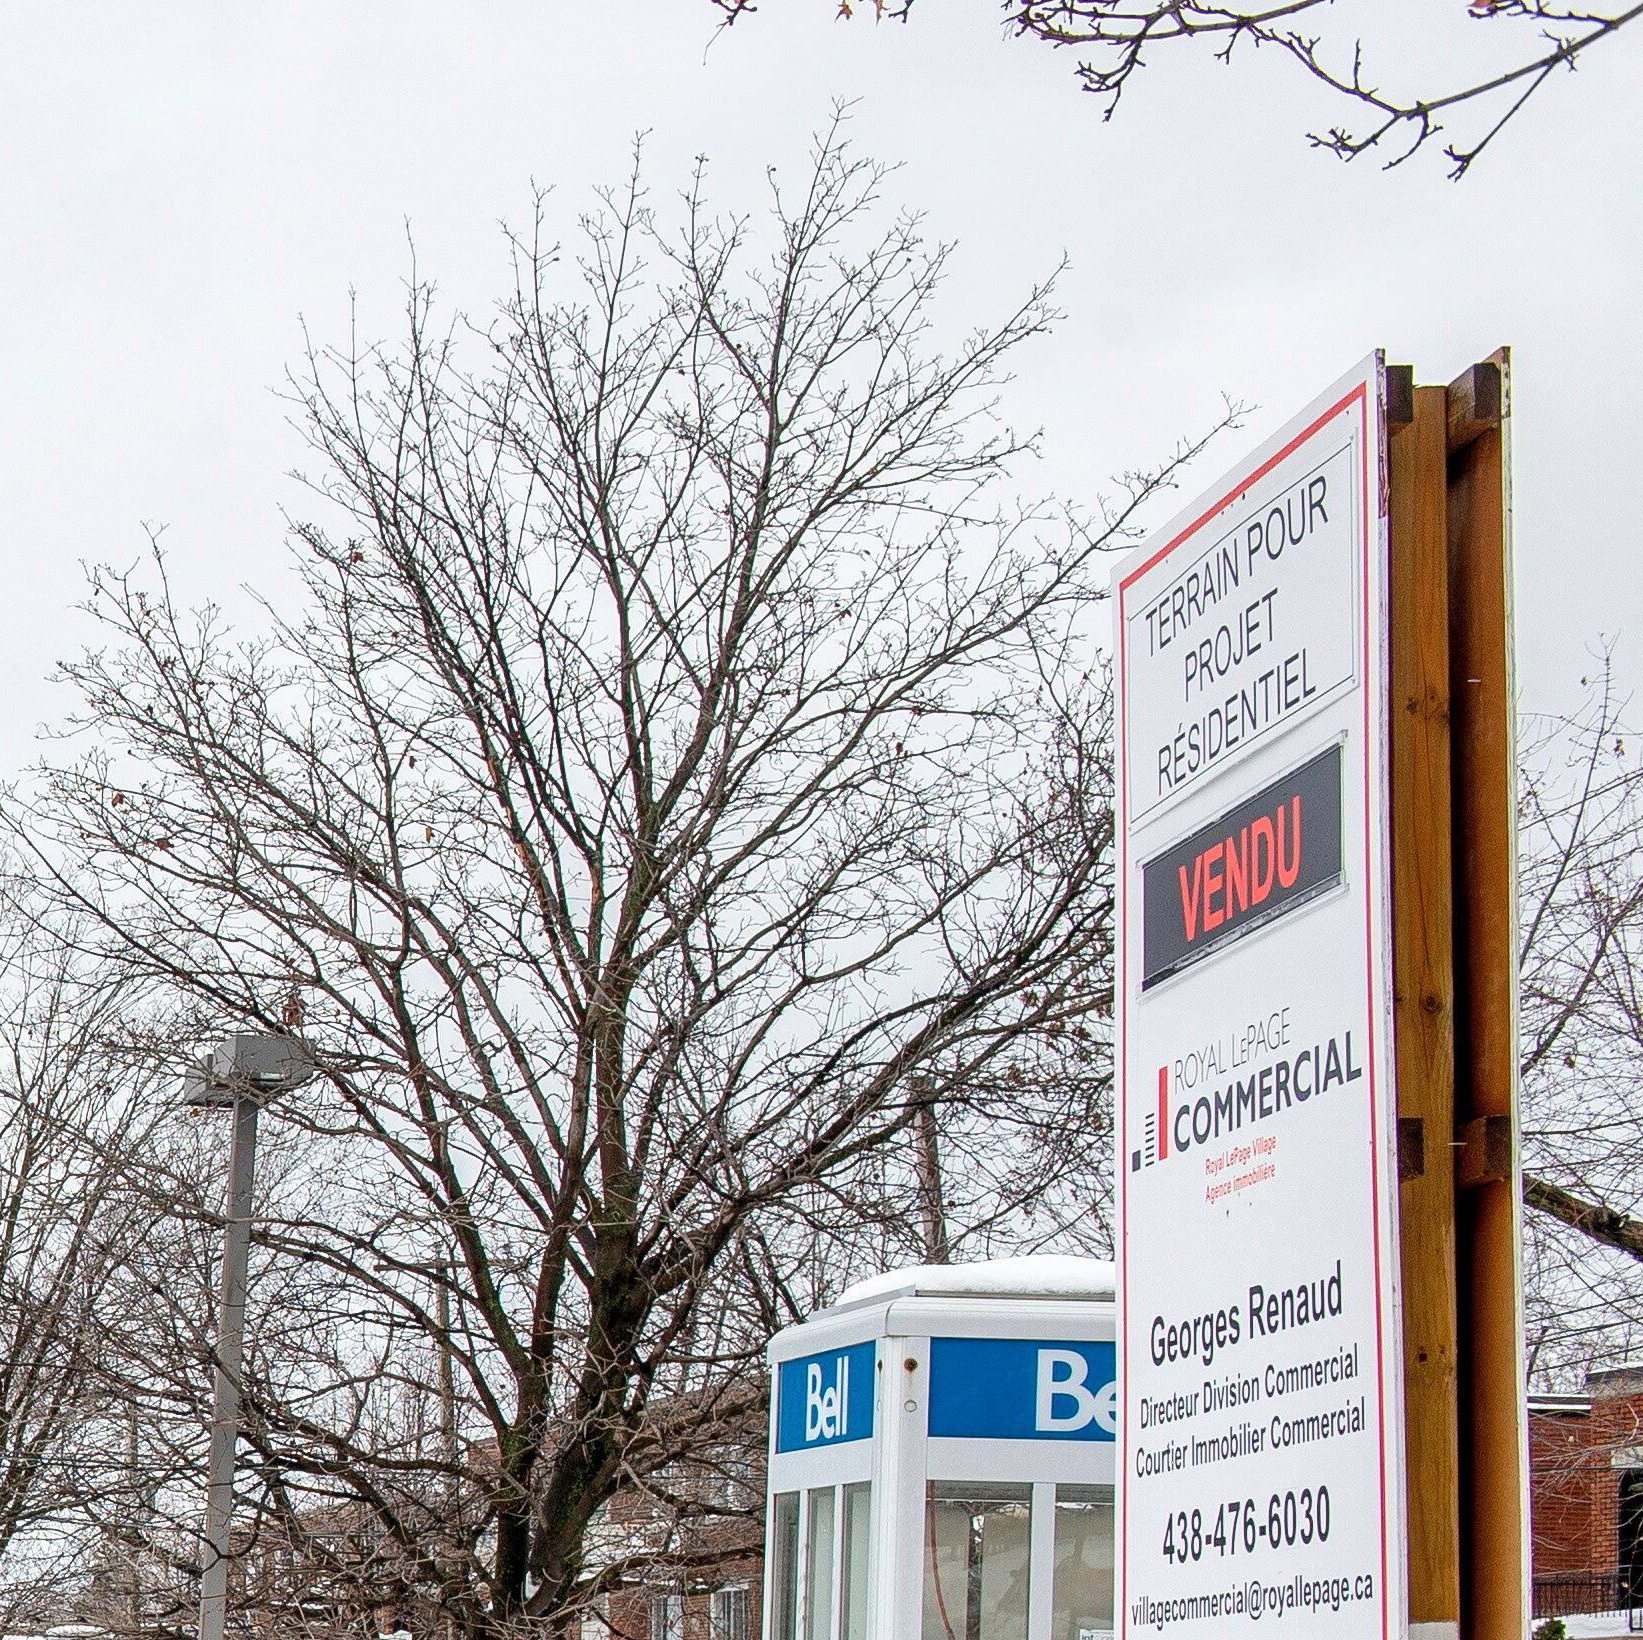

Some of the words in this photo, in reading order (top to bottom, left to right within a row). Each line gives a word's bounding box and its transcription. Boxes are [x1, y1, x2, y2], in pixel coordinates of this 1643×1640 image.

[1145, 538, 1239, 658] TERRAIN
[1247, 475, 1328, 577] POUR
[1185, 587, 1278, 703] PROJET
[1158, 648, 1316, 797] RÉSIDENTIEL
[1178, 794, 1302, 942] VENDU
[1174, 1039, 1227, 1094] ROYAL
[1174, 1030, 1362, 1152] COMMERCIAL
[1205, 1151, 1225, 1177] Royal
[1252, 1135, 1277, 1156] Village
[1205, 1182, 1233, 1204] Agence
[1151, 1305, 1240, 1366] Georges
[1249, 1259, 1343, 1339] Renaud
[805, 1355, 850, 1442] Bell
[1140, 1386, 1199, 1429] Directeur
[1203, 1373, 1260, 1413] Division
[1265, 1342, 1358, 1398] Commercial
[1136, 1440, 1188, 1478] Courtier
[1192, 1424, 1266, 1466] Immobilier
[1271, 1396, 1365, 1449] Commercial
[1163, 1485, 1330, 1564] 438-476-6030
[1132, 1573, 1373, 1631] villagecommercial@royallepage.ca
